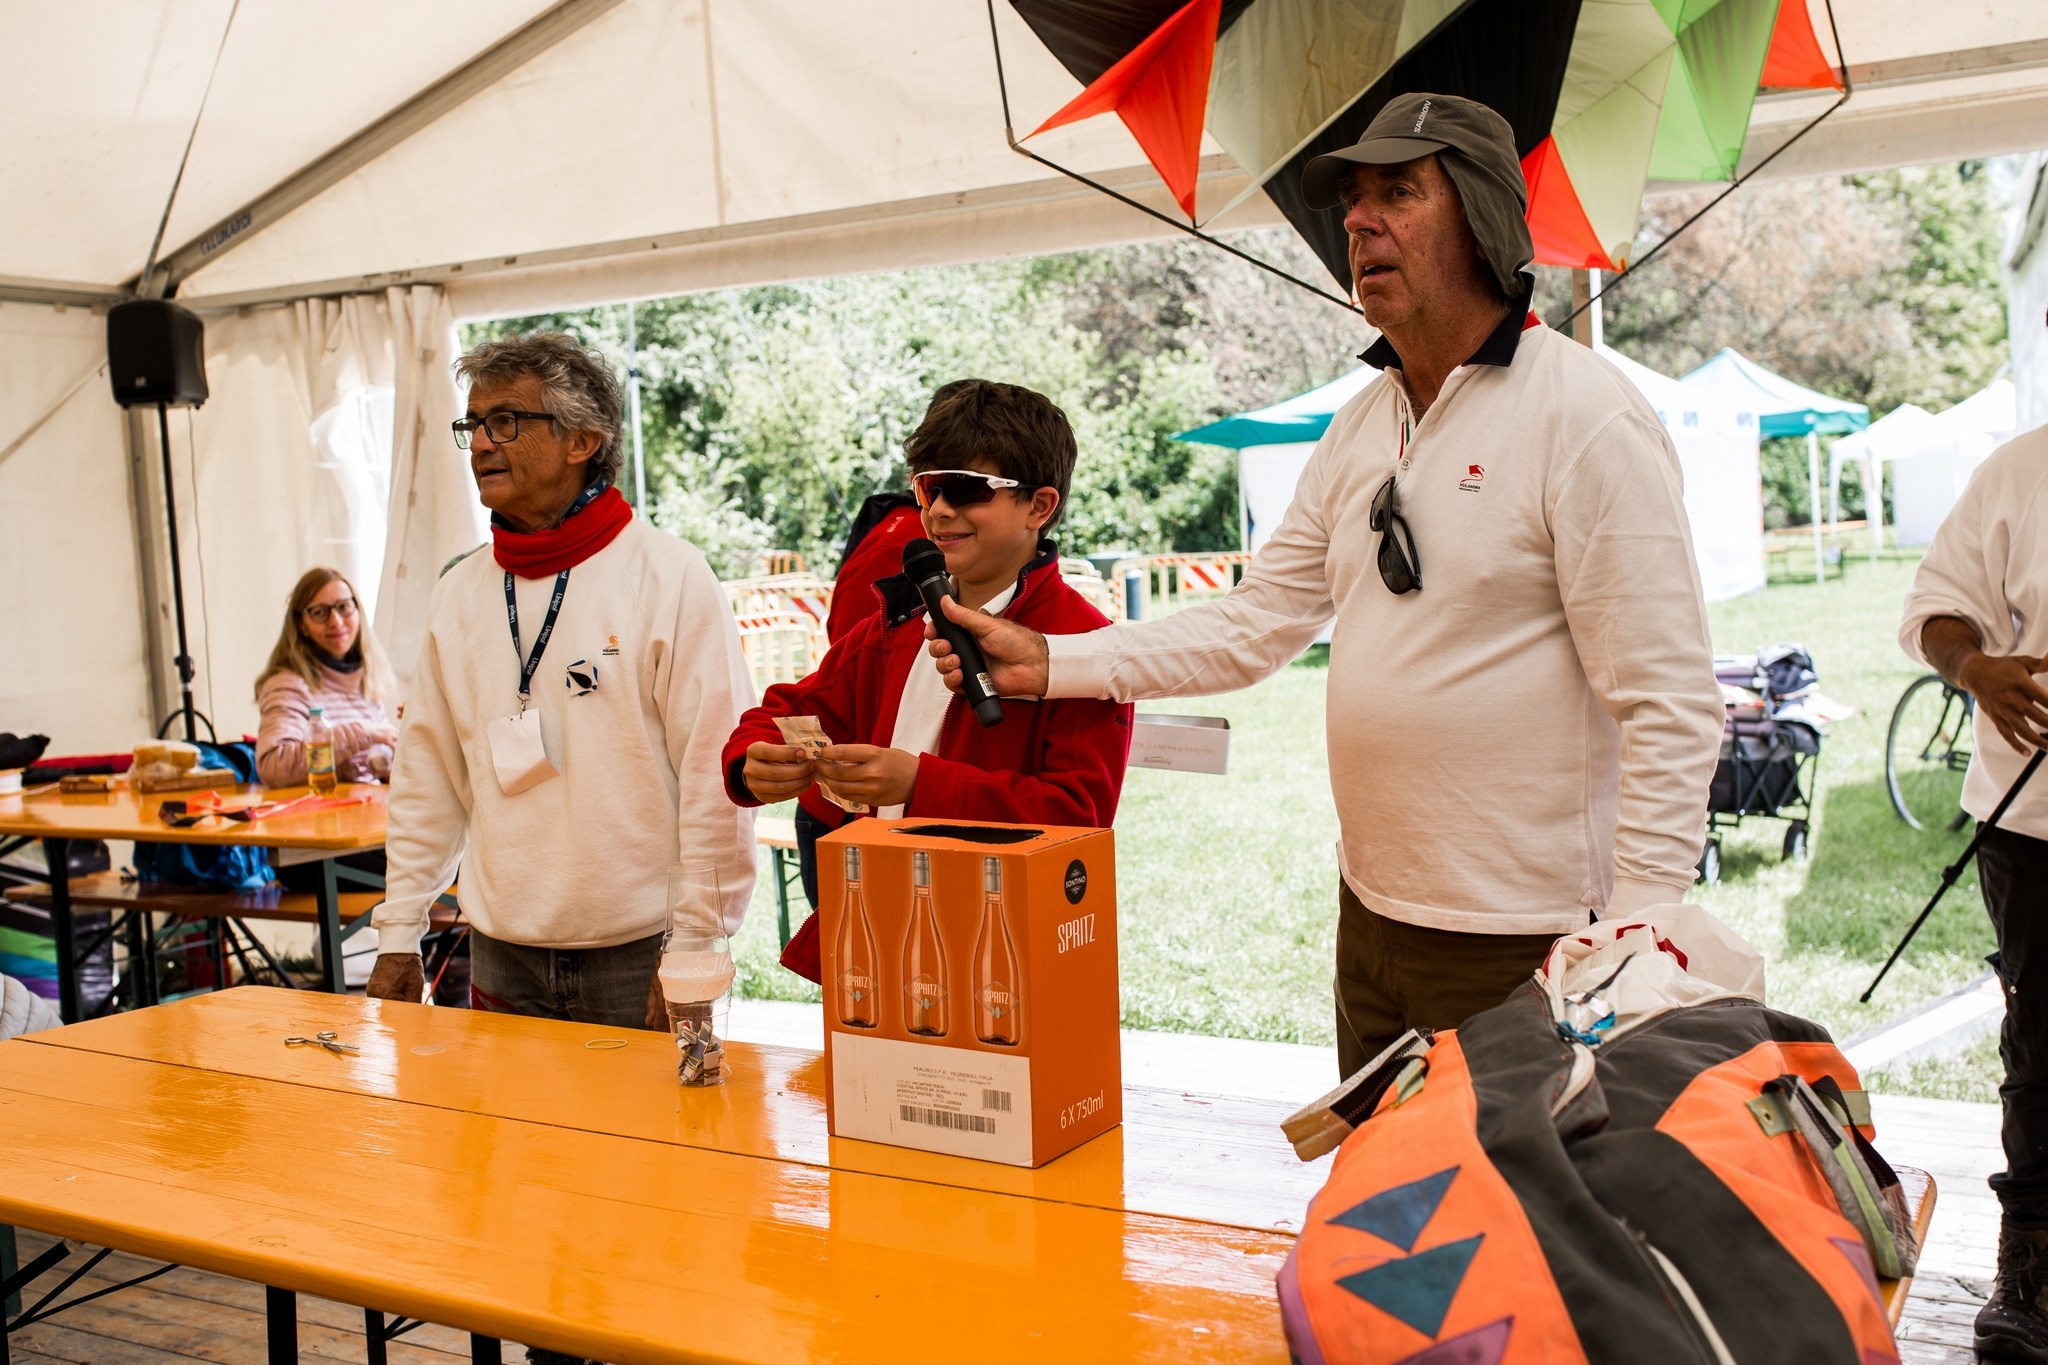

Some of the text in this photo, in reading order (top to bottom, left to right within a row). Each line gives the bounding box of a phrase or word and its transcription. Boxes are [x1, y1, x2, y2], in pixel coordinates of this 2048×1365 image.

[1413, 99, 1432, 134] SALOMON
[1065, 875, 1086, 889] SONTINO
[1057, 912, 1096, 954] SPRITZ
[845, 974, 869, 989] SPRITZ
[913, 982, 938, 997] SPRITZ
[984, 990, 1009, 1005] SPRITZ
[1060, 1089, 1104, 1129] 6 X 750ml
